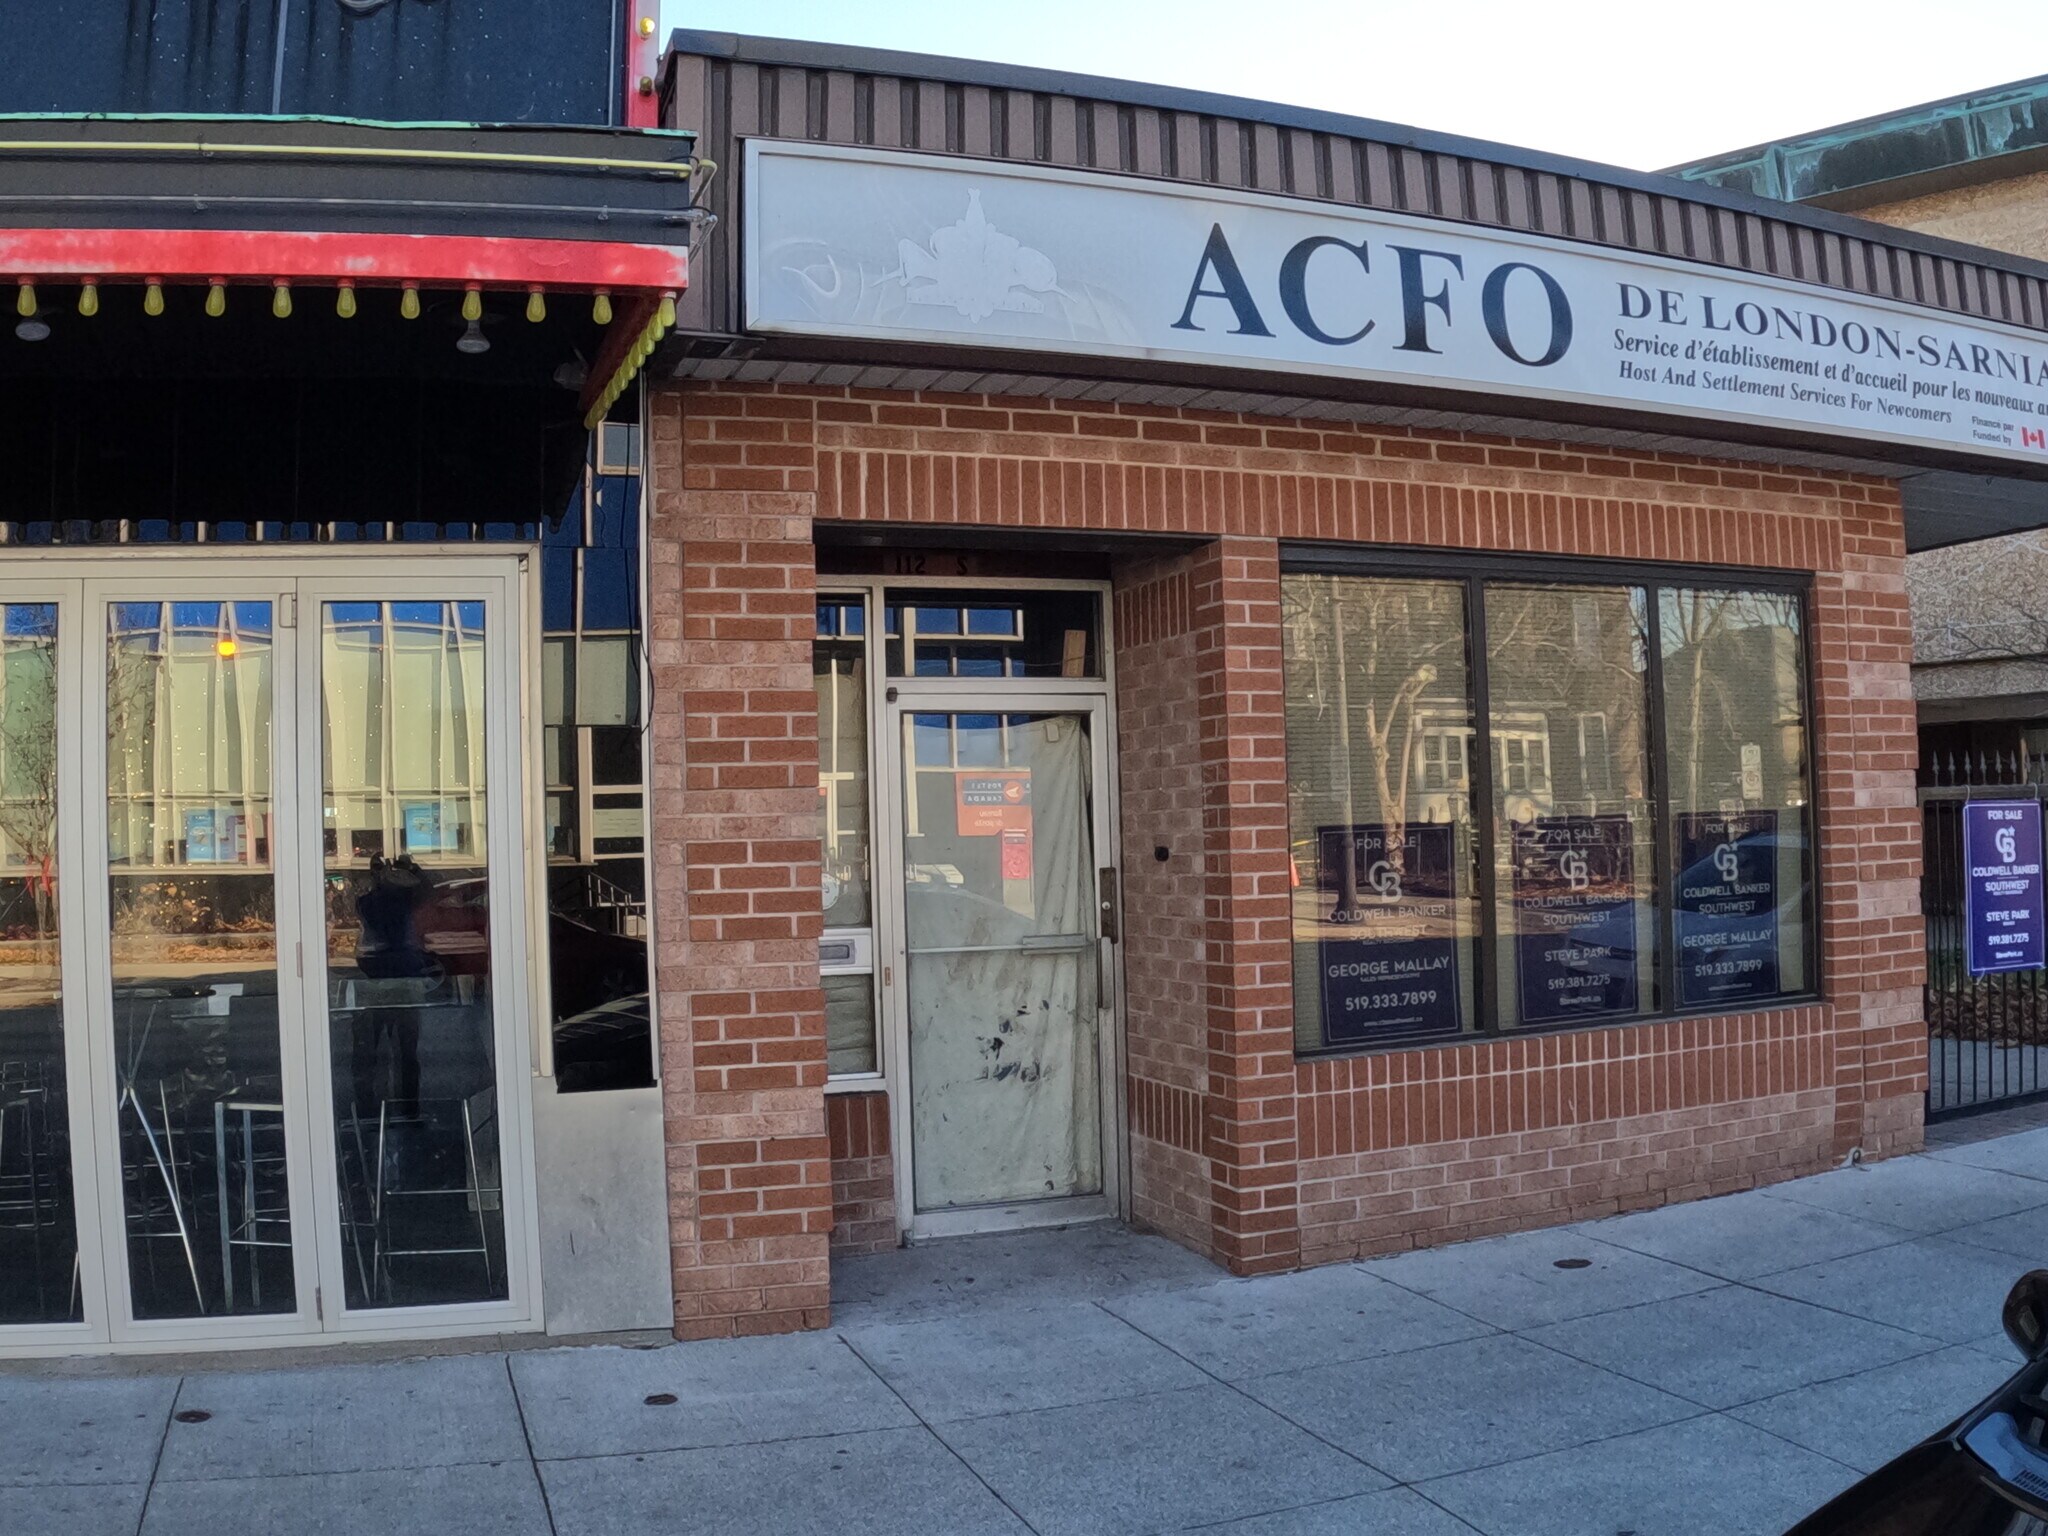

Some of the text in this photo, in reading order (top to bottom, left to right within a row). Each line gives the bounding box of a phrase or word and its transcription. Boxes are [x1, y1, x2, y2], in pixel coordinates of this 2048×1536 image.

[1170, 222, 1573, 367] ACFO
[1616, 282, 1688, 326] DE
[1614, 329, 1679, 359] Service
[1824, 361, 1838, 380] et
[1912, 381, 1948, 400] pour
[1952, 381, 1971, 402] les
[1974, 389, 2034, 414] nouveaux
[1619, 360, 1953, 424] Host And Settlement Services For Newcomers
[1972, 430, 2001, 442] Funded
[1988, 810, 2023, 820] FOR SALE
[1549, 829, 1571, 840] FOR
[1705, 824, 1724, 834] FOR
[1356, 836, 1417, 850] FOR SALE
[1972, 864, 2040, 877] COLDWELL BANKER
[1683, 883, 1770, 898] COLDWELL BANKER
[1985, 880, 2029, 892] SOUTHWEST
[1523, 893, 1628, 910] COLDWELL BANKER
[1699, 900, 1756, 914] SOUTHWEST
[1329, 904, 1447, 923] COLDWELL BANKER
[1543, 911, 1611, 926] SOUTHWEST
[1986, 910, 2030, 922] STEVE PARK
[1683, 929, 1773, 947] GEORGE MALLAY
[1544, 946, 1612, 962] STEVE PARK
[1328, 961, 1389, 978] GEORGE
[1394, 956, 1450, 972] MALLAY
[1695, 959, 1763, 976] 519.333.7899
[1548, 974, 1611, 990] 519.381.7275
[1345, 990, 1437, 1011] 519.333.7899
